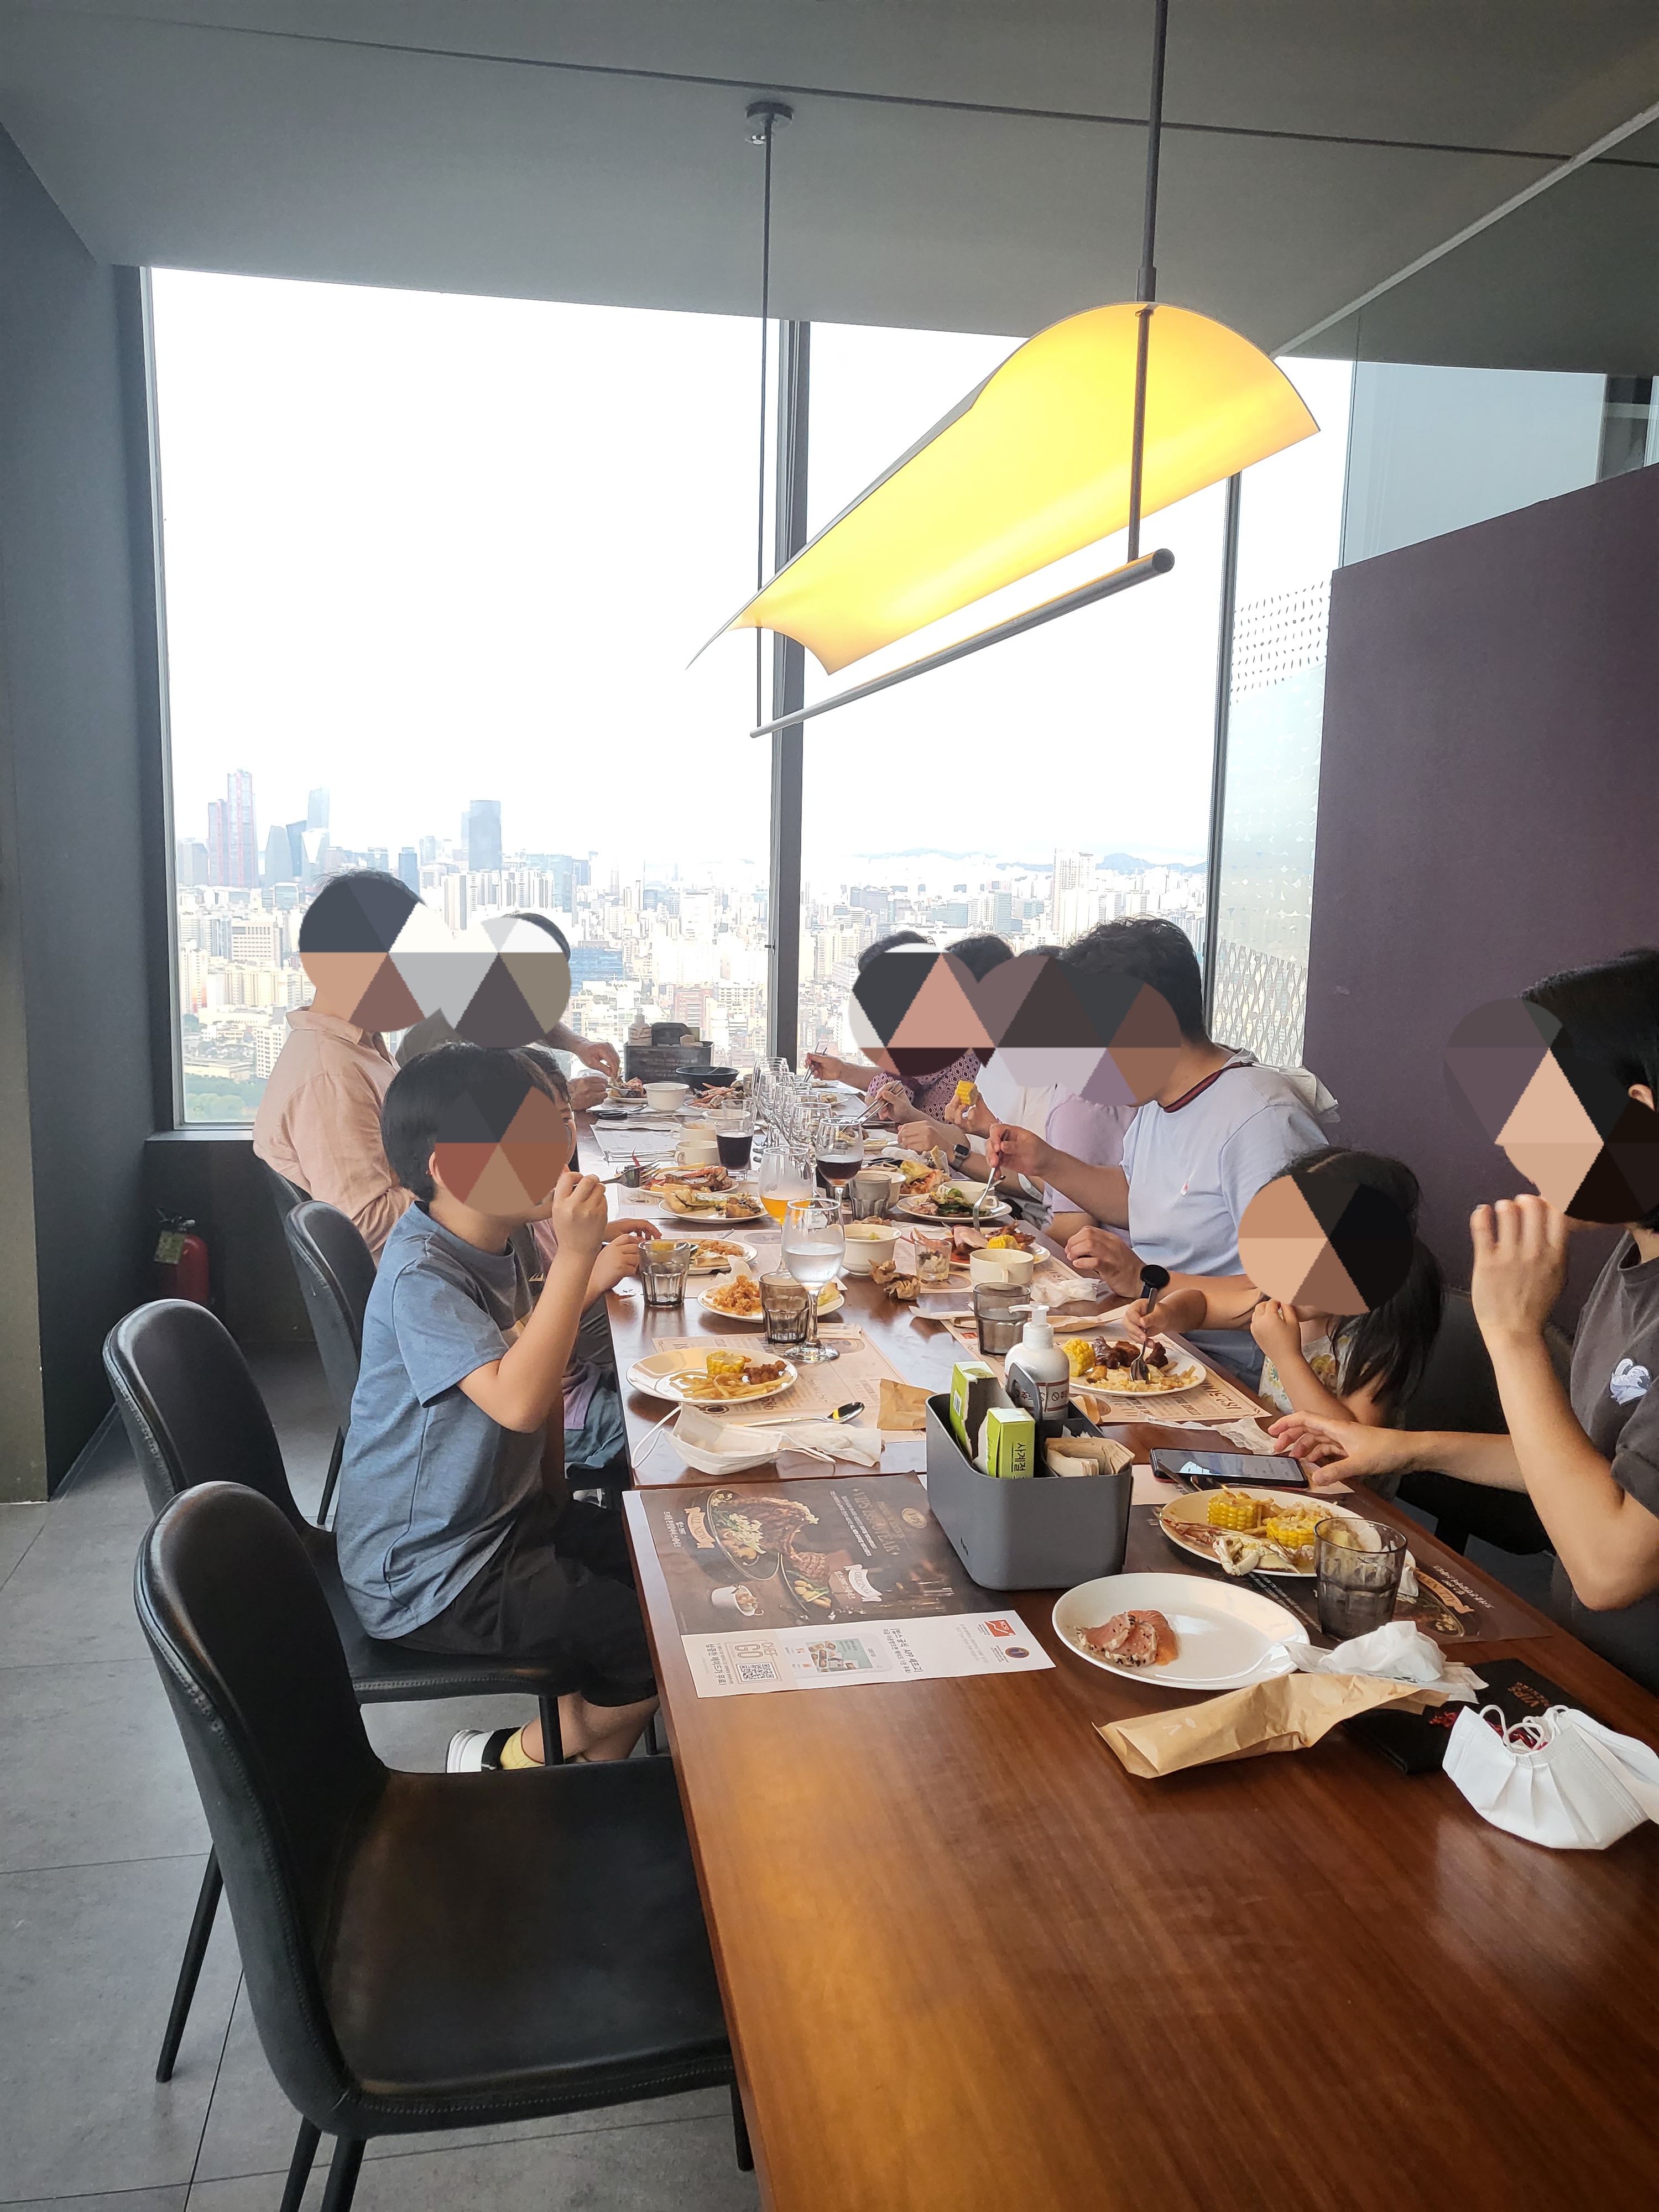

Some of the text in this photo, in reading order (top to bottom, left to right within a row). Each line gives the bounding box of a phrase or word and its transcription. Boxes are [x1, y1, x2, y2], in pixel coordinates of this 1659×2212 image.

[1014, 1442, 1026, 1472] 사계절
[907, 1512, 921, 1524] VIPS
[691, 1514, 707, 1540] ALL NEW
[871, 1524, 901, 1552] STEAK
[854, 1572, 872, 1595] ORIGINAL
[999, 1620, 1010, 1630] NCSI
[706, 1644, 718, 1656] 상큼한
[735, 1644, 763, 1658] GO
[761, 1642, 778, 1657] CHEF
[896, 1638, 909, 1647] 공식
[903, 1648, 914, 1657] APP
[710, 1656, 723, 1673] 에이드가
[716, 1674, 727, 1685] 무료!
[1507, 1686, 1540, 1707] VIPS
